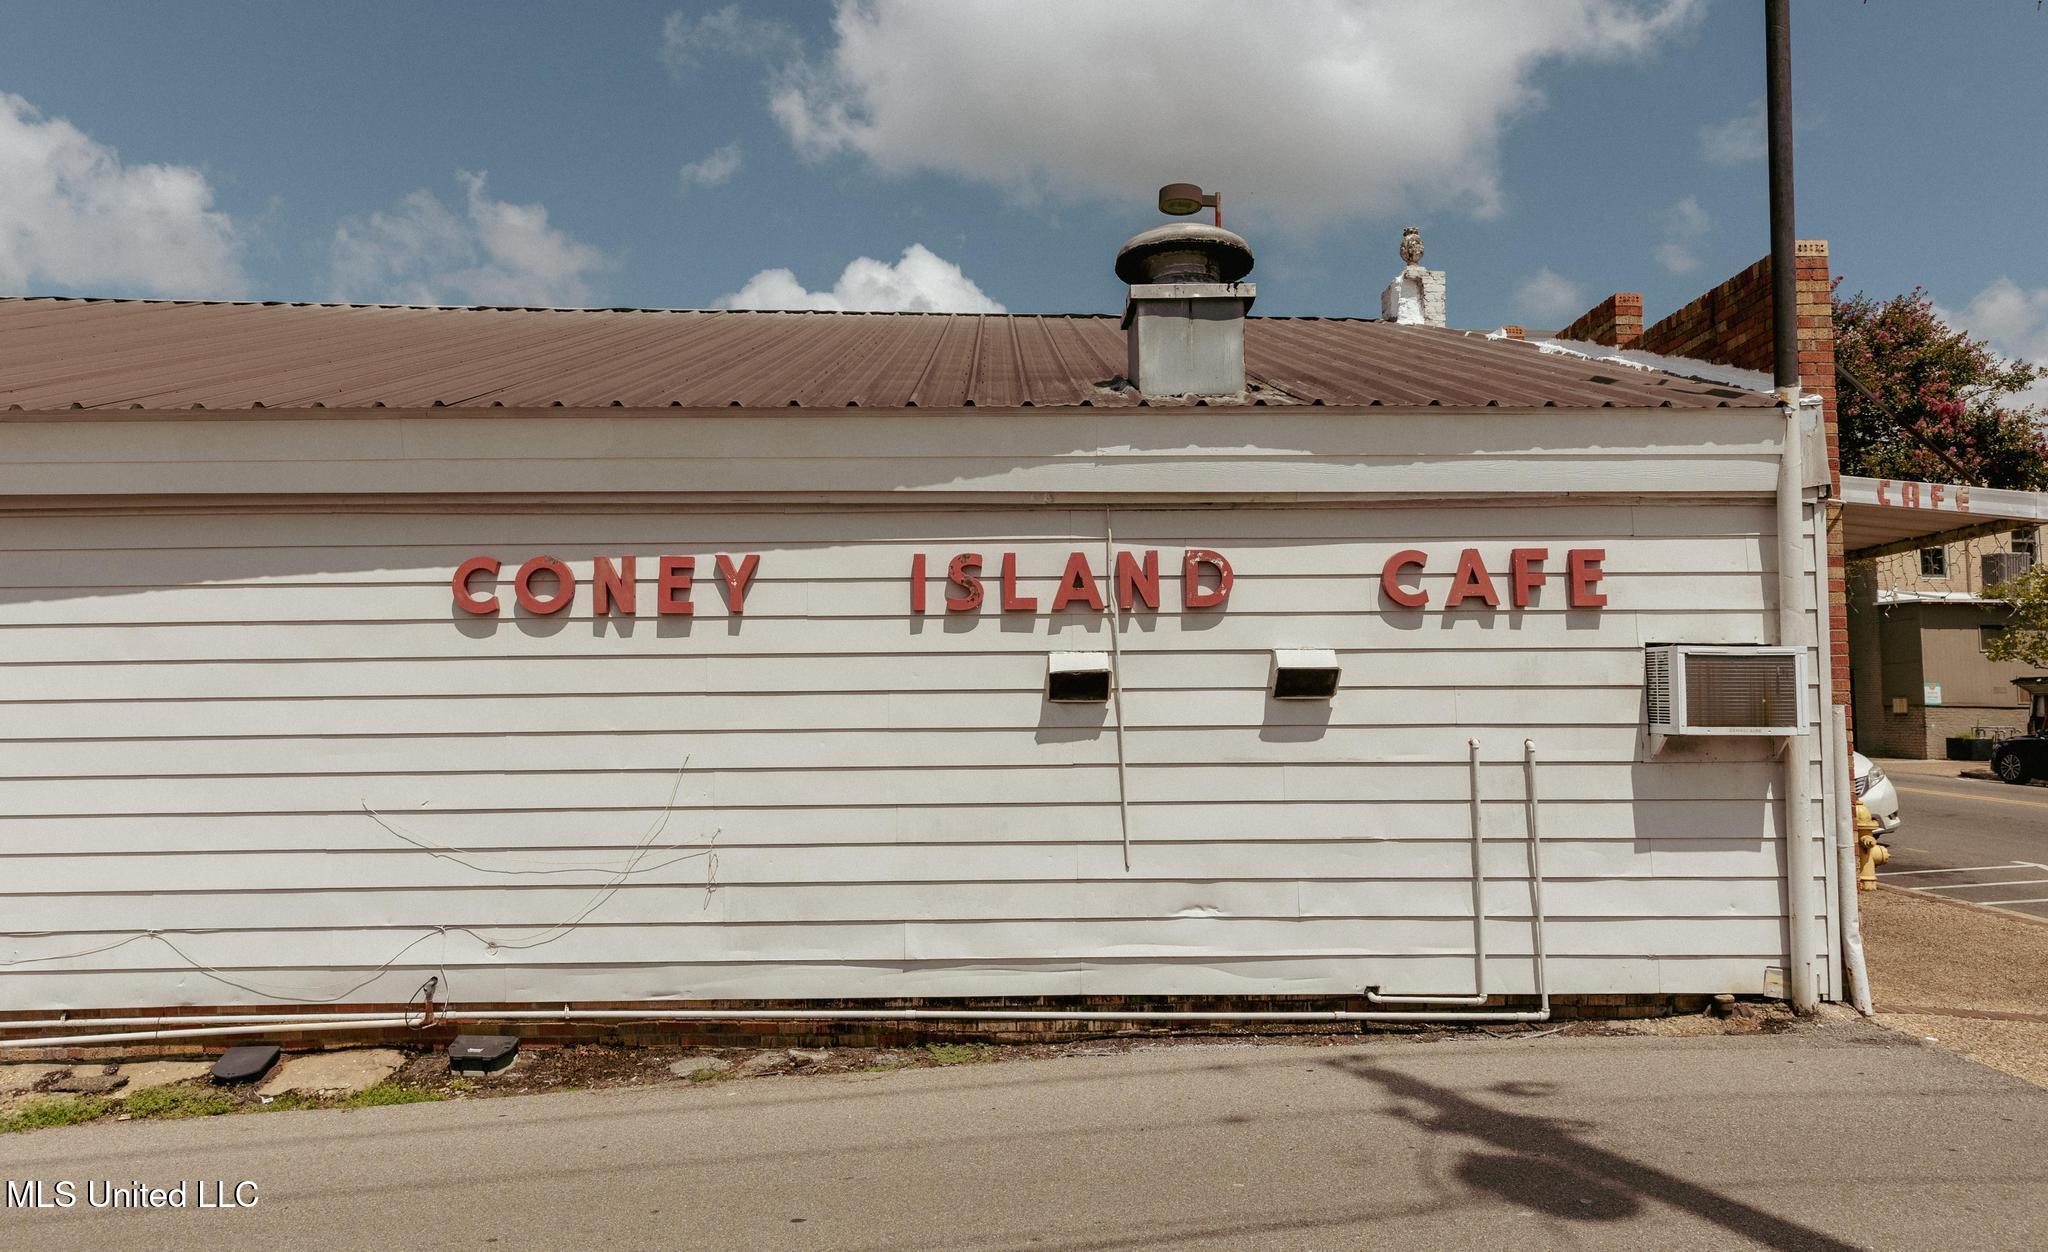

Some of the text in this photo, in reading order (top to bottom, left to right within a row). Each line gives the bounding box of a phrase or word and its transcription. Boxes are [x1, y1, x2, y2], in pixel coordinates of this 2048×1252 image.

[1876, 480, 1970, 512] CAFE
[453, 549, 1608, 615] CONEY ISLAND CAFE
